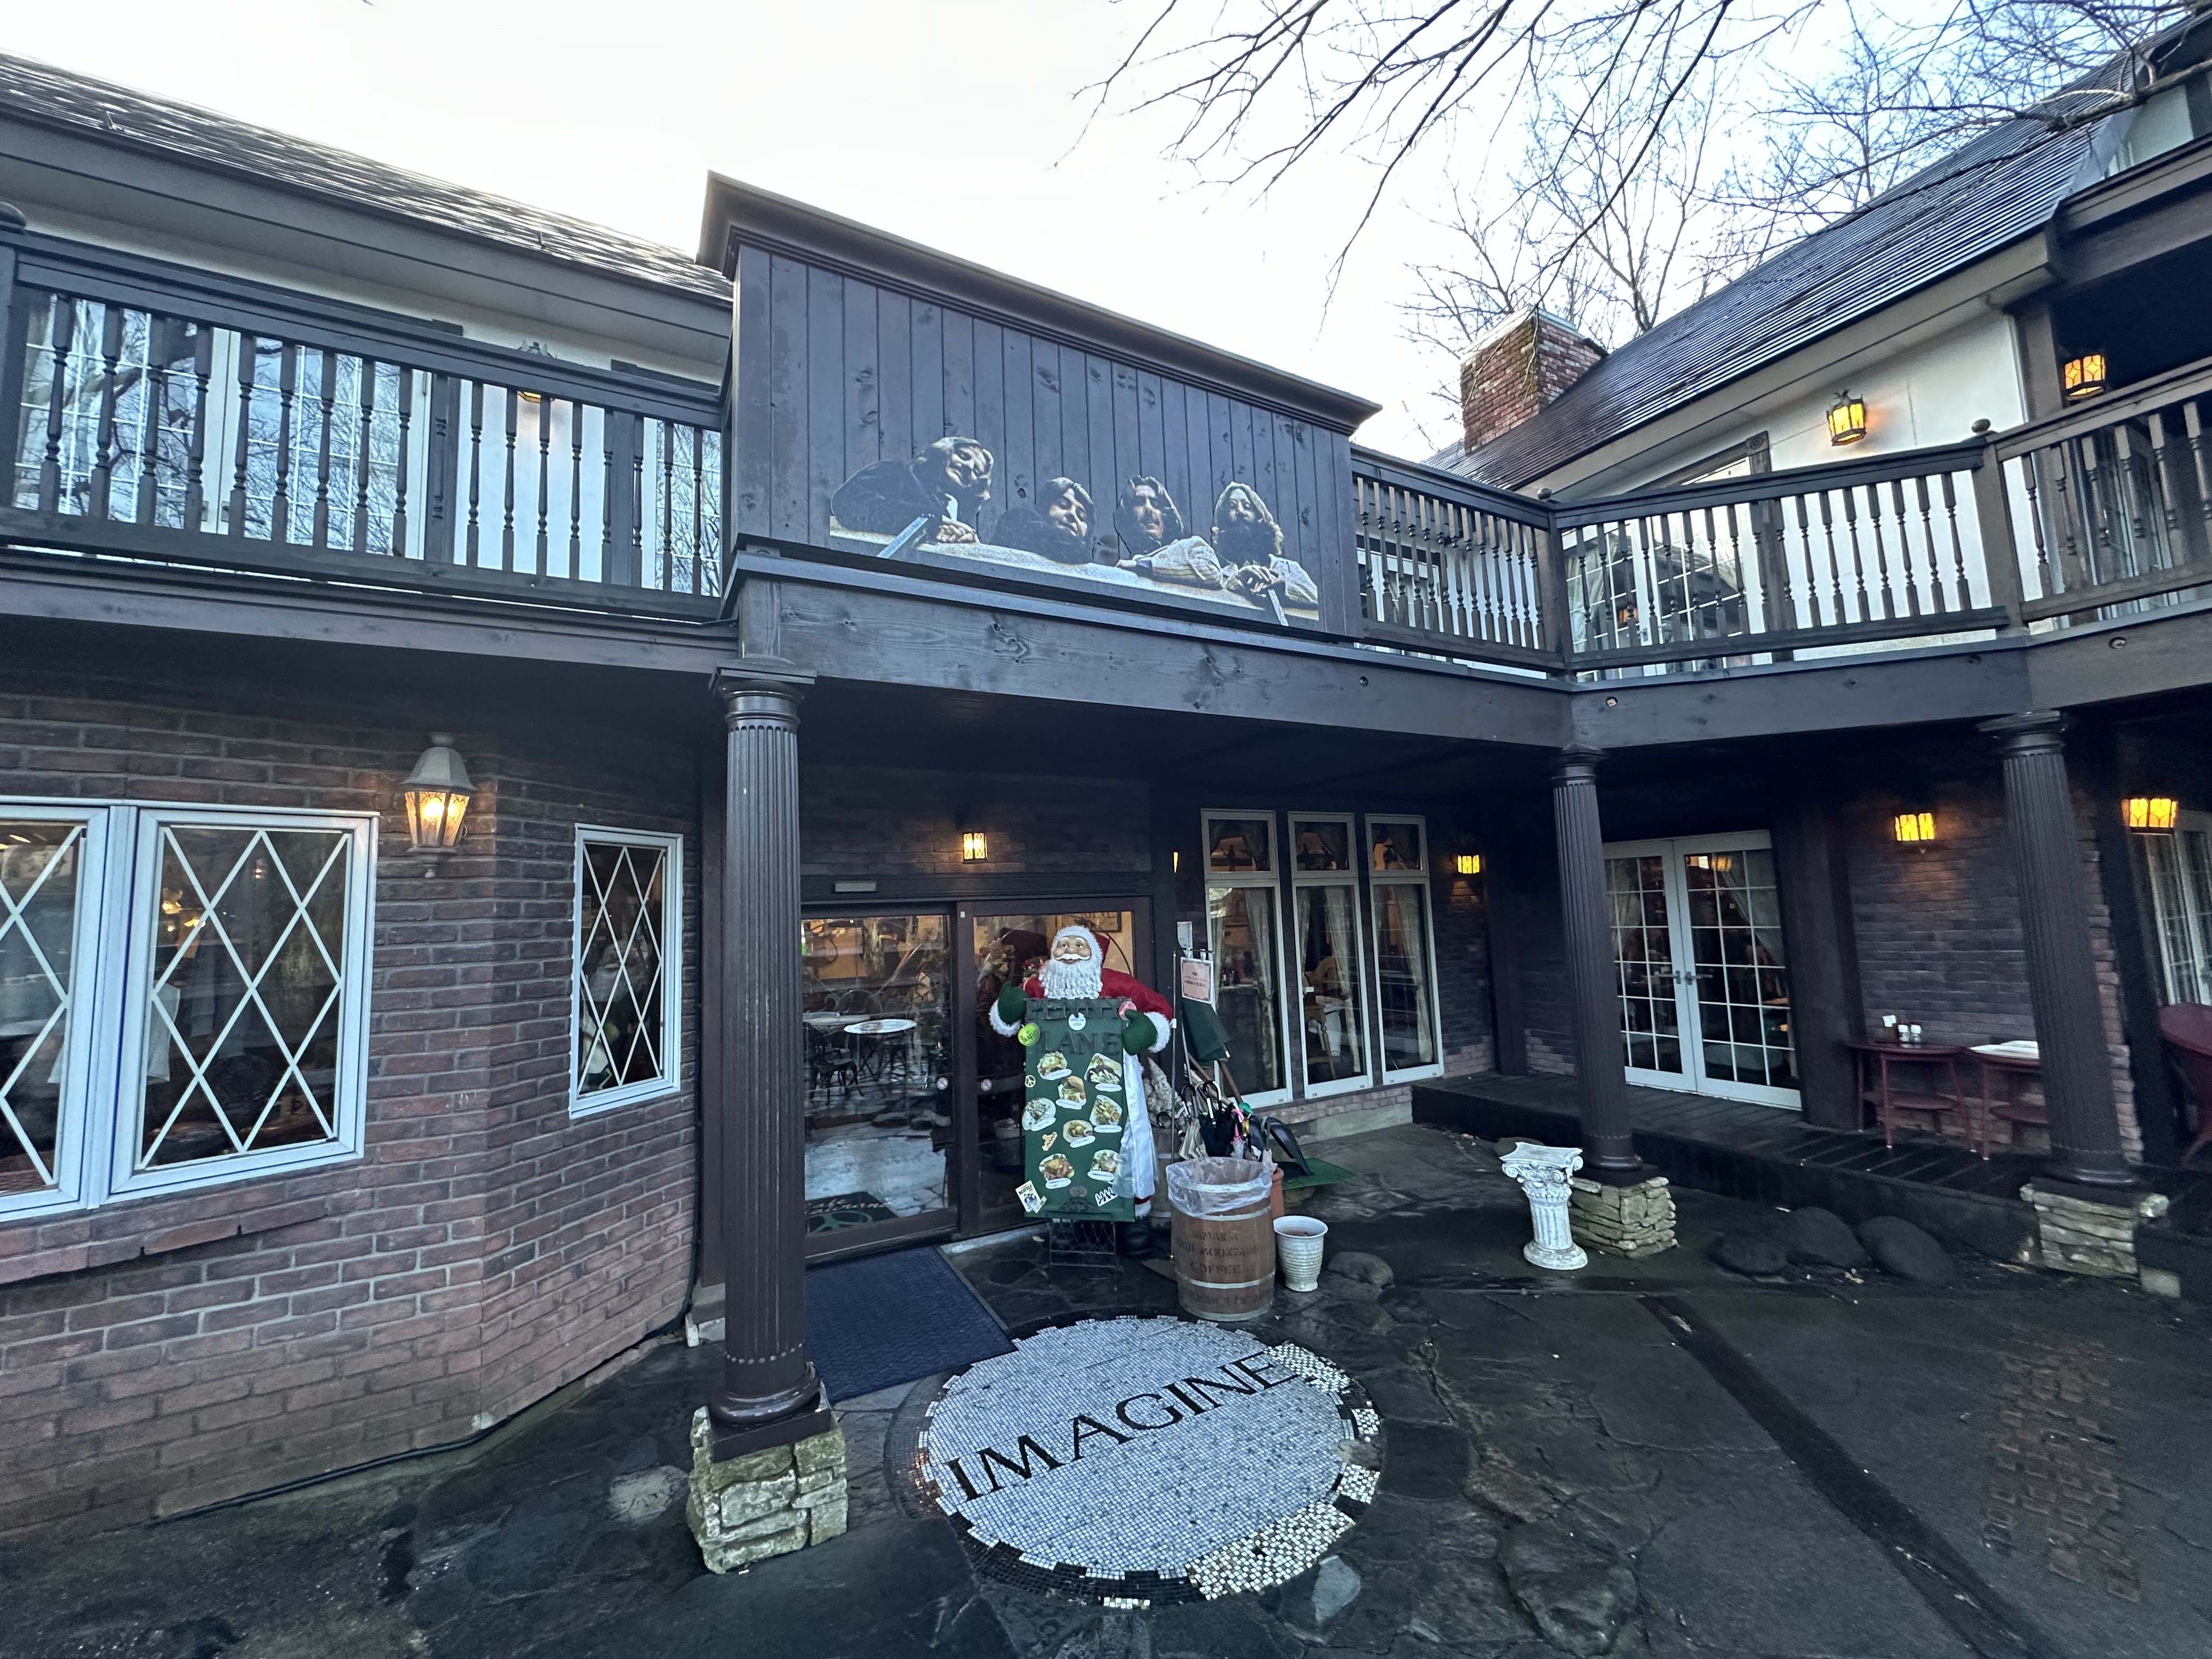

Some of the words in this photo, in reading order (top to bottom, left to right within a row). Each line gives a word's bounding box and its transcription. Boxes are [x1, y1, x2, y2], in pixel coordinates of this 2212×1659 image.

[1026, 996, 1132, 1020] PENNY
[1042, 1030, 1122, 1056] LANE
[1190, 1261, 1242, 1274] COFFEE
[947, 1351, 1300, 1502] IMAGINE
